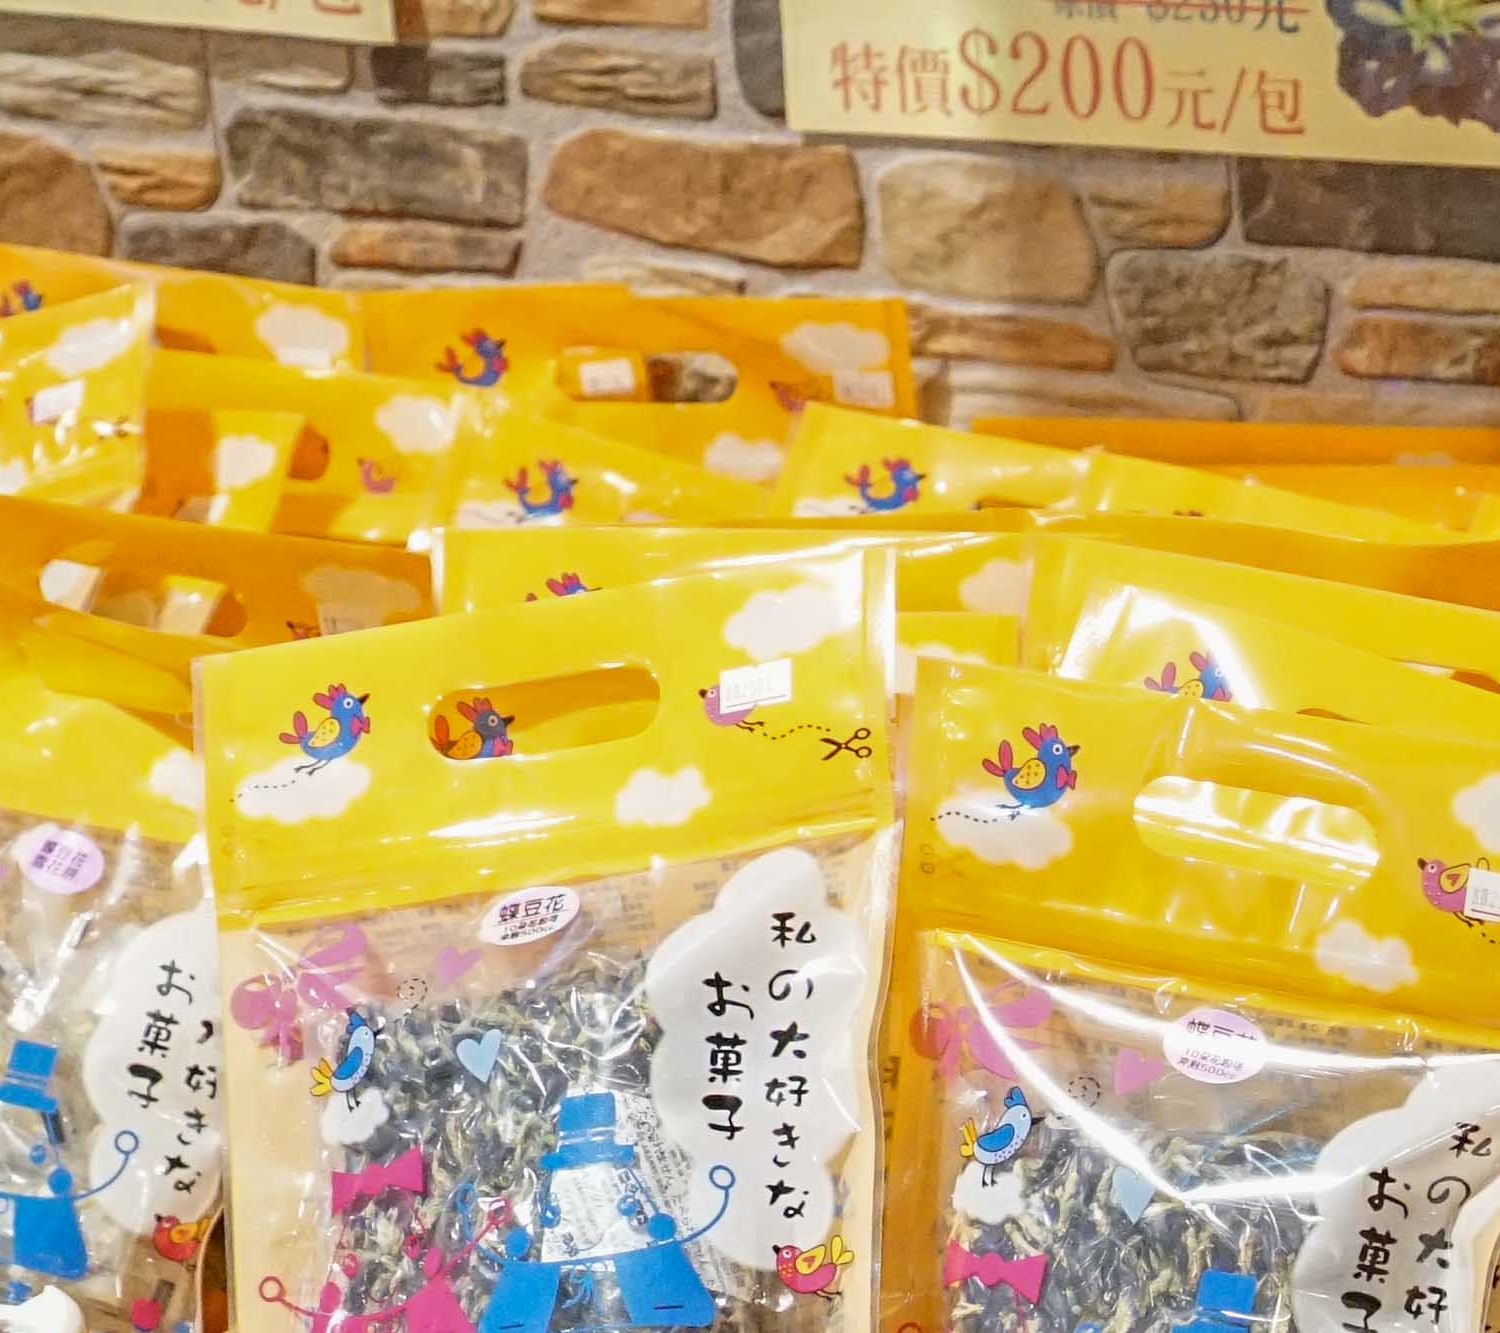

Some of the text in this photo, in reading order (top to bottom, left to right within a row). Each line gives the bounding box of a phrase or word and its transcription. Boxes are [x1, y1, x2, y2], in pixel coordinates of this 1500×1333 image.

[831, 28, 1306, 136] 特價$200元/包
[127, 959, 196, 1109] お菓子
[702, 971, 755, 1140] お菓子
[764, 911, 817, 1219] 私の大好きな
